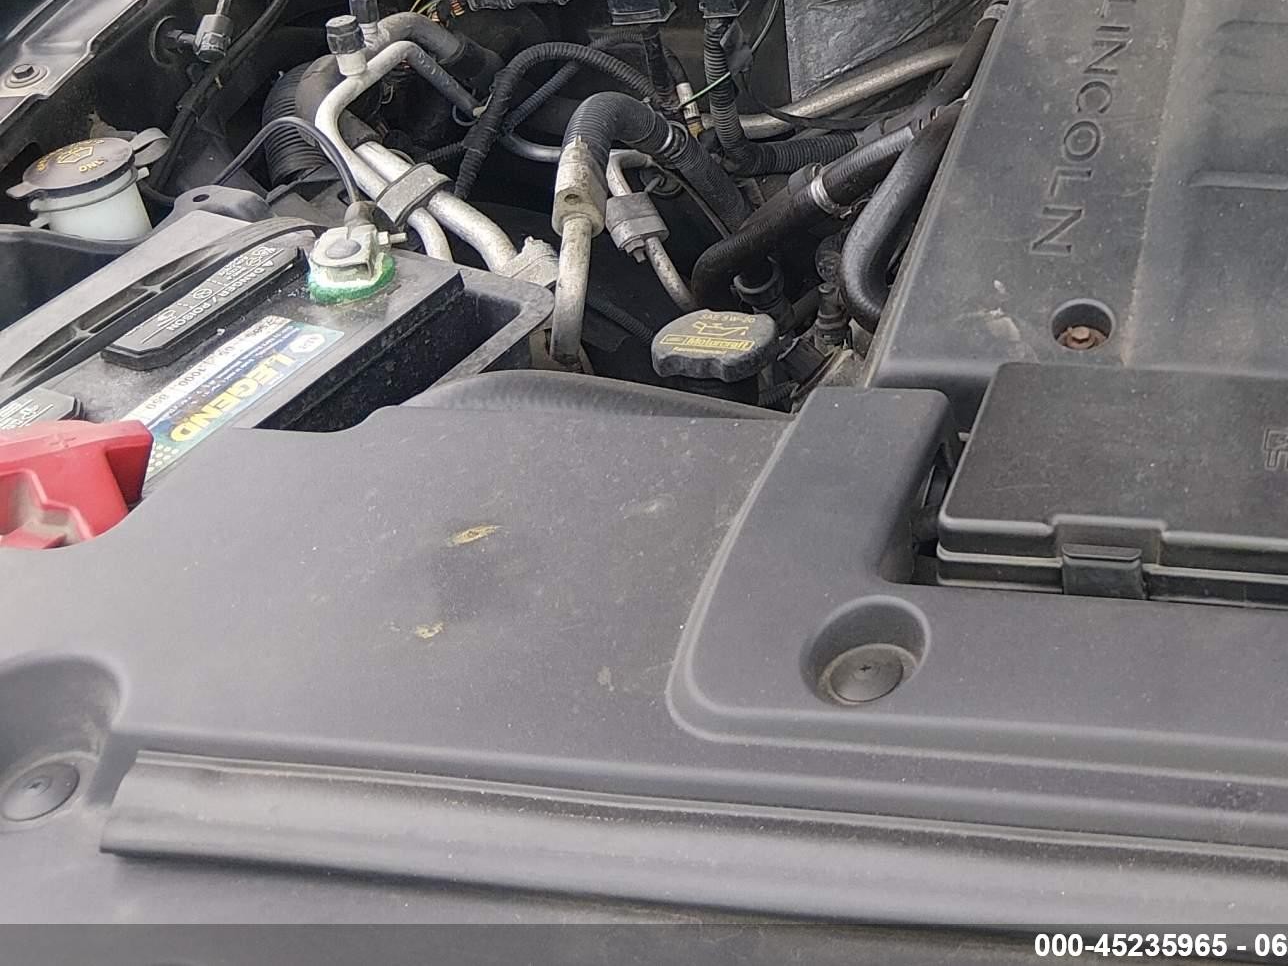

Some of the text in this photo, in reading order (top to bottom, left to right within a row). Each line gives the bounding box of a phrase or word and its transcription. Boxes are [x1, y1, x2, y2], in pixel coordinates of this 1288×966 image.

[219, 267, 265, 297] DANGER
[166, 303, 211, 331] POISON
[686, 336, 749, 351] Motorcraft
[169, 351, 297, 443] LEGEND
